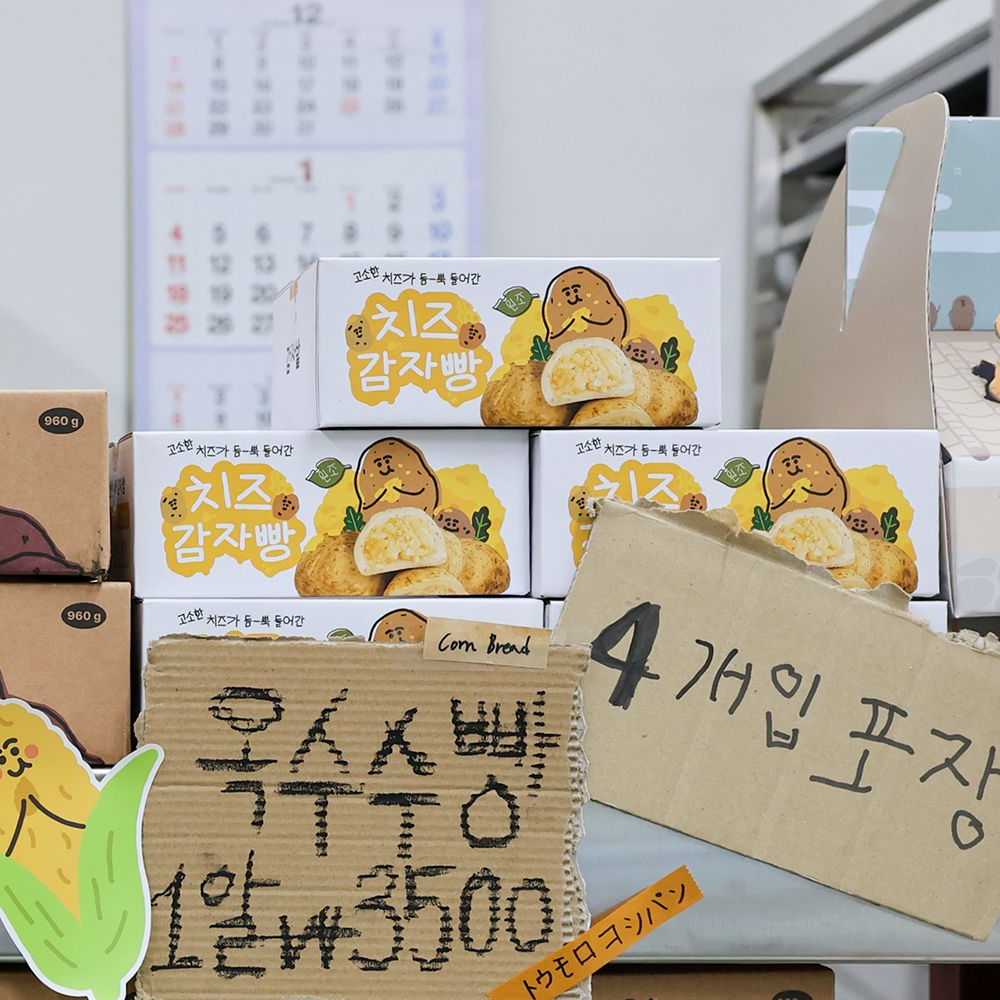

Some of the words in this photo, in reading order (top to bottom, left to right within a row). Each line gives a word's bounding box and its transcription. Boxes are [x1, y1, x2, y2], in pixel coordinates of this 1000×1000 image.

[300, 160, 312, 182] 1
[171, 224, 183, 242] 4
[213, 223, 226, 245] 5
[256, 223, 270, 245] 6
[300, 223, 313, 243] 7
[344, 223, 358, 245] 8
[387, 223, 401, 245] 9
[429, 220, 452, 242] 10
[353, 266, 380, 284] 고소한
[382, 272, 416, 285] 치즈가
[450, 272, 481, 285] 들어간
[371, 299, 459, 340] 치즈
[357, 350, 484, 393] 감자빵
[44, 415, 69, 427] 960
[71, 417, 79, 428] g
[167, 438, 194, 456] 고소한
[196, 445, 229, 457] 치즈가
[263, 445, 294, 457] 들어간
[575, 437, 602, 455] 고소한
[604, 444, 638, 456] 치즈가
[671, 444, 702, 456] 들어간
[185, 471, 273, 514] 치즈
[172, 521, 297, 564] 감자빵
[67, 610, 92, 622] 960
[93, 612, 102, 624] g
[177, 607, 204, 625] 고소한
[206, 613, 240, 627] 치즈가
[273, 614, 305, 628] 들어간
[438, 634, 477, 654] Corn
[487, 631, 531, 656] Bread
[195, 685, 561, 860] 옥수수빵
[522, 883, 686, 1000] トウモロコシパン
